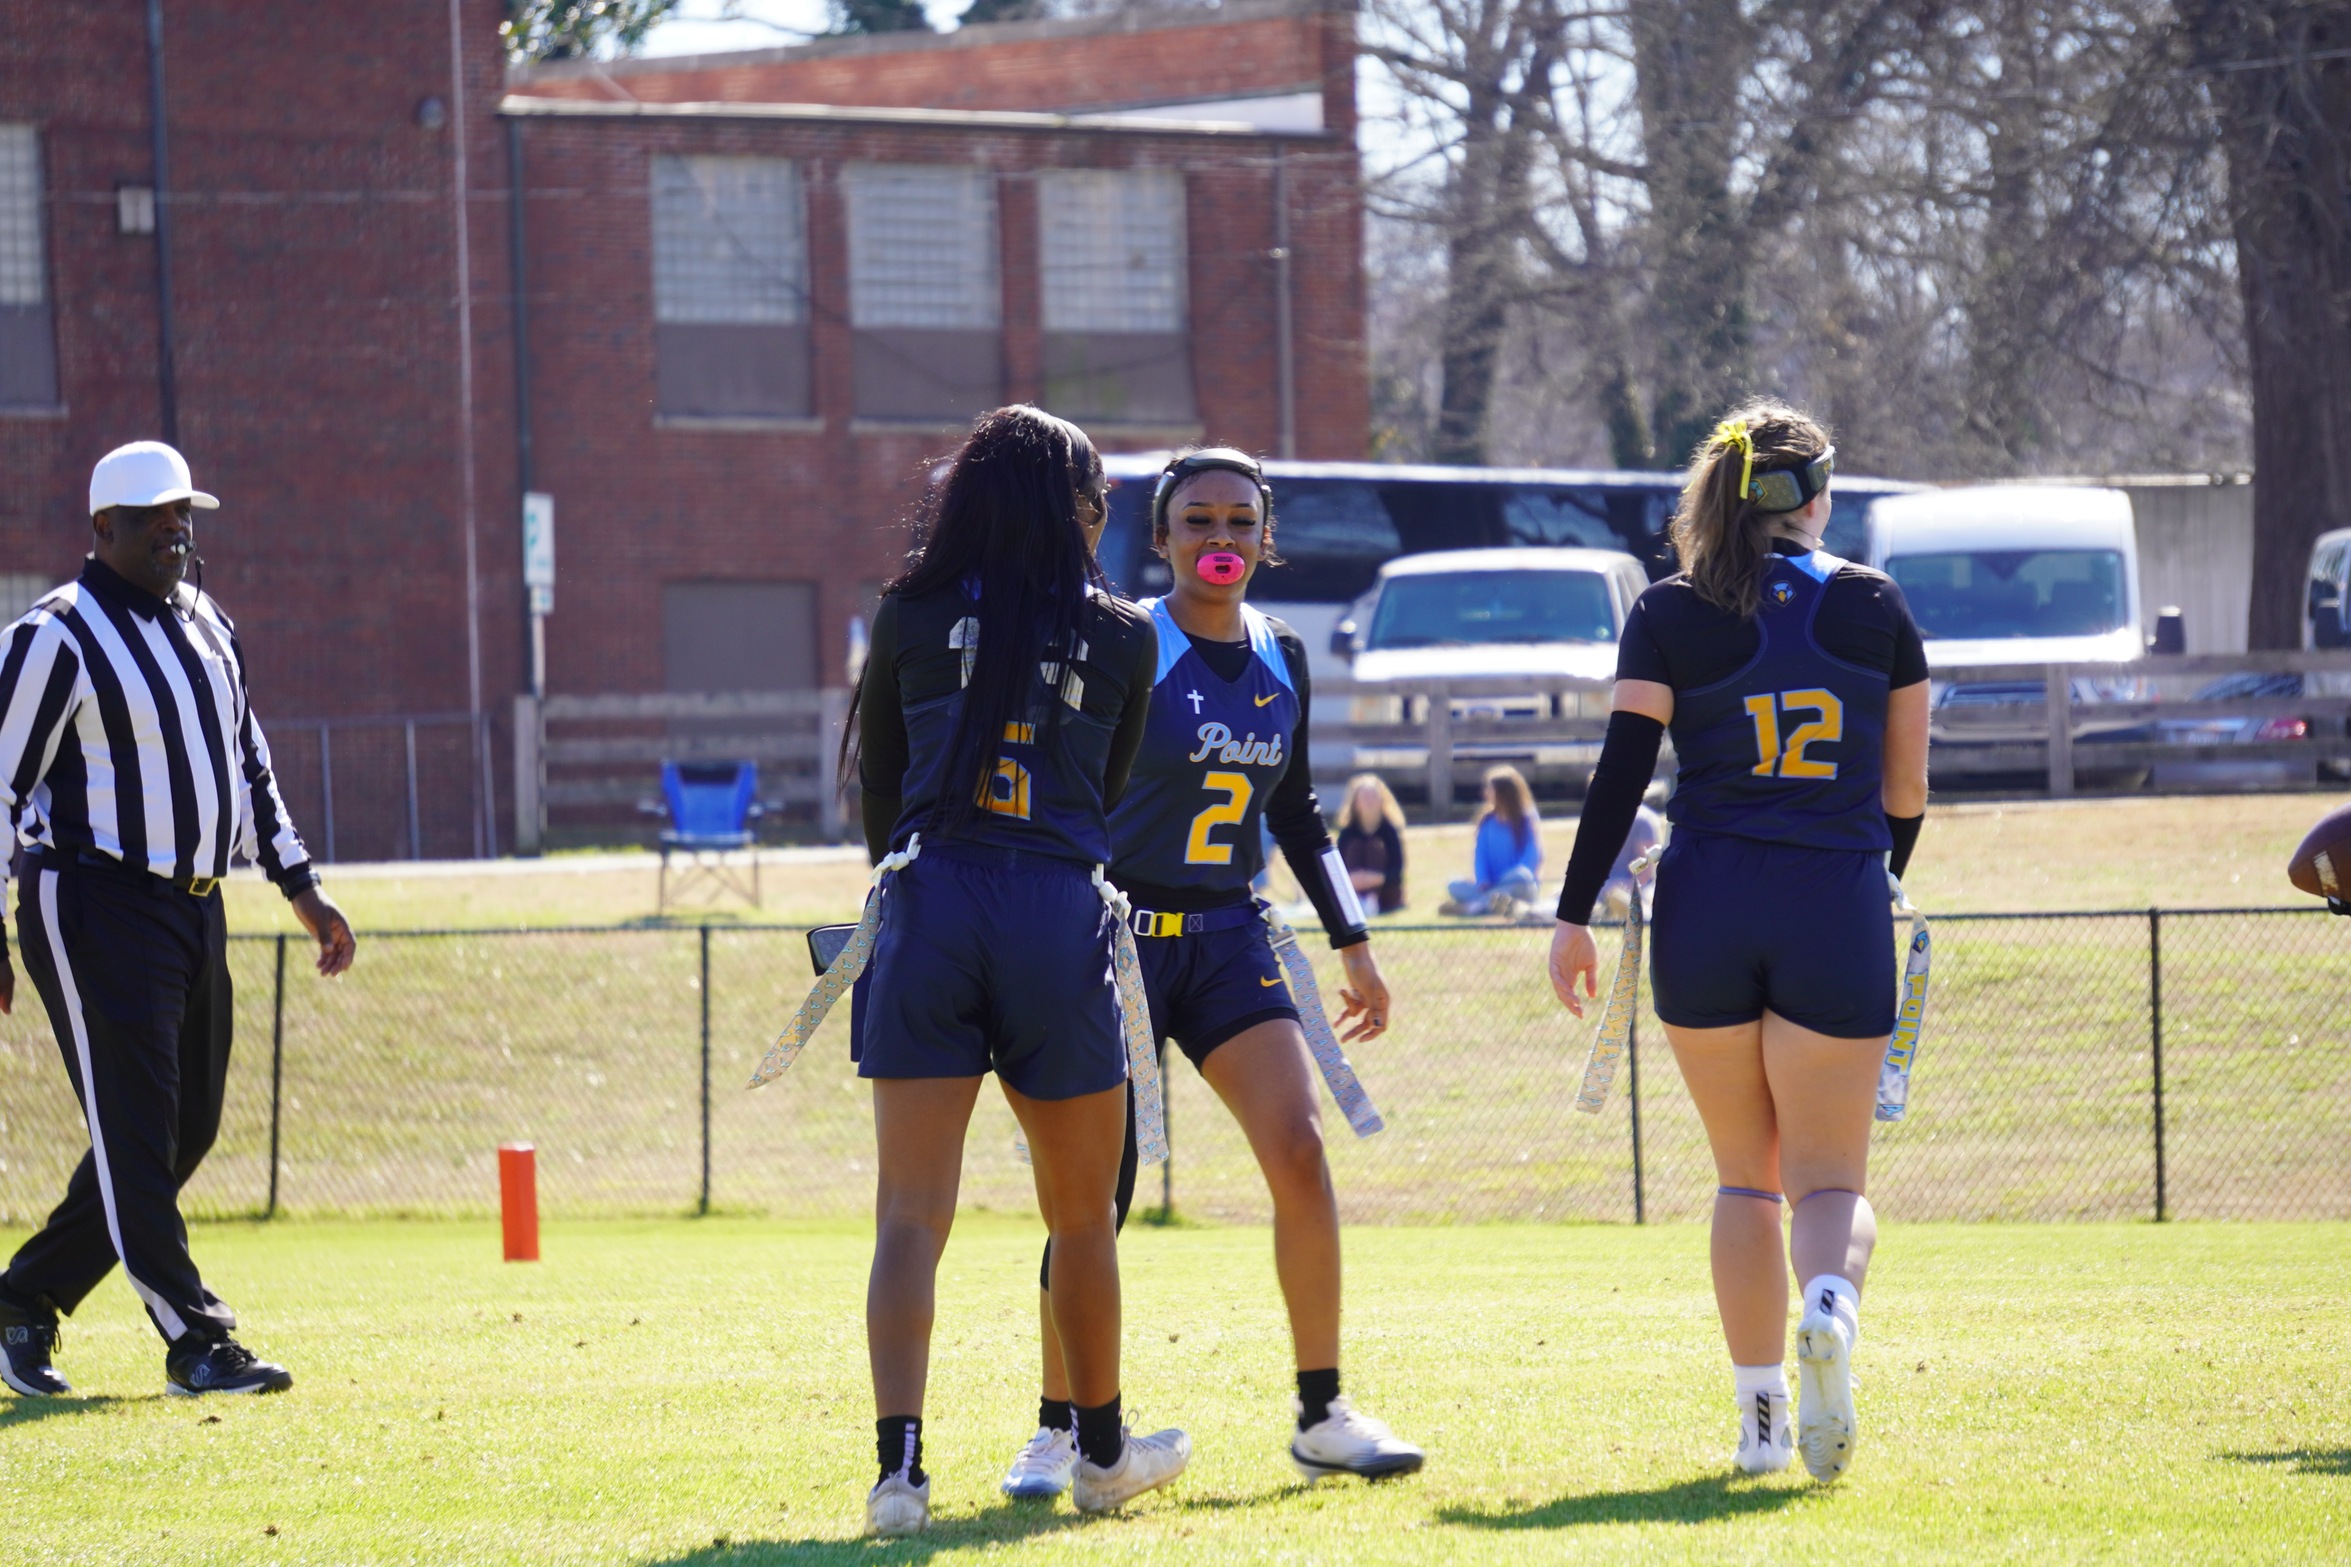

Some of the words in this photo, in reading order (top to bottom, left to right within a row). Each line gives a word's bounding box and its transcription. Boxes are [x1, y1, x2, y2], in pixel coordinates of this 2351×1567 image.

[1189, 722, 1283, 766] Point
[1744, 688, 1843, 780] 12
[1184, 771, 1254, 865] 2
[1885, 970, 1929, 1077] POINT
